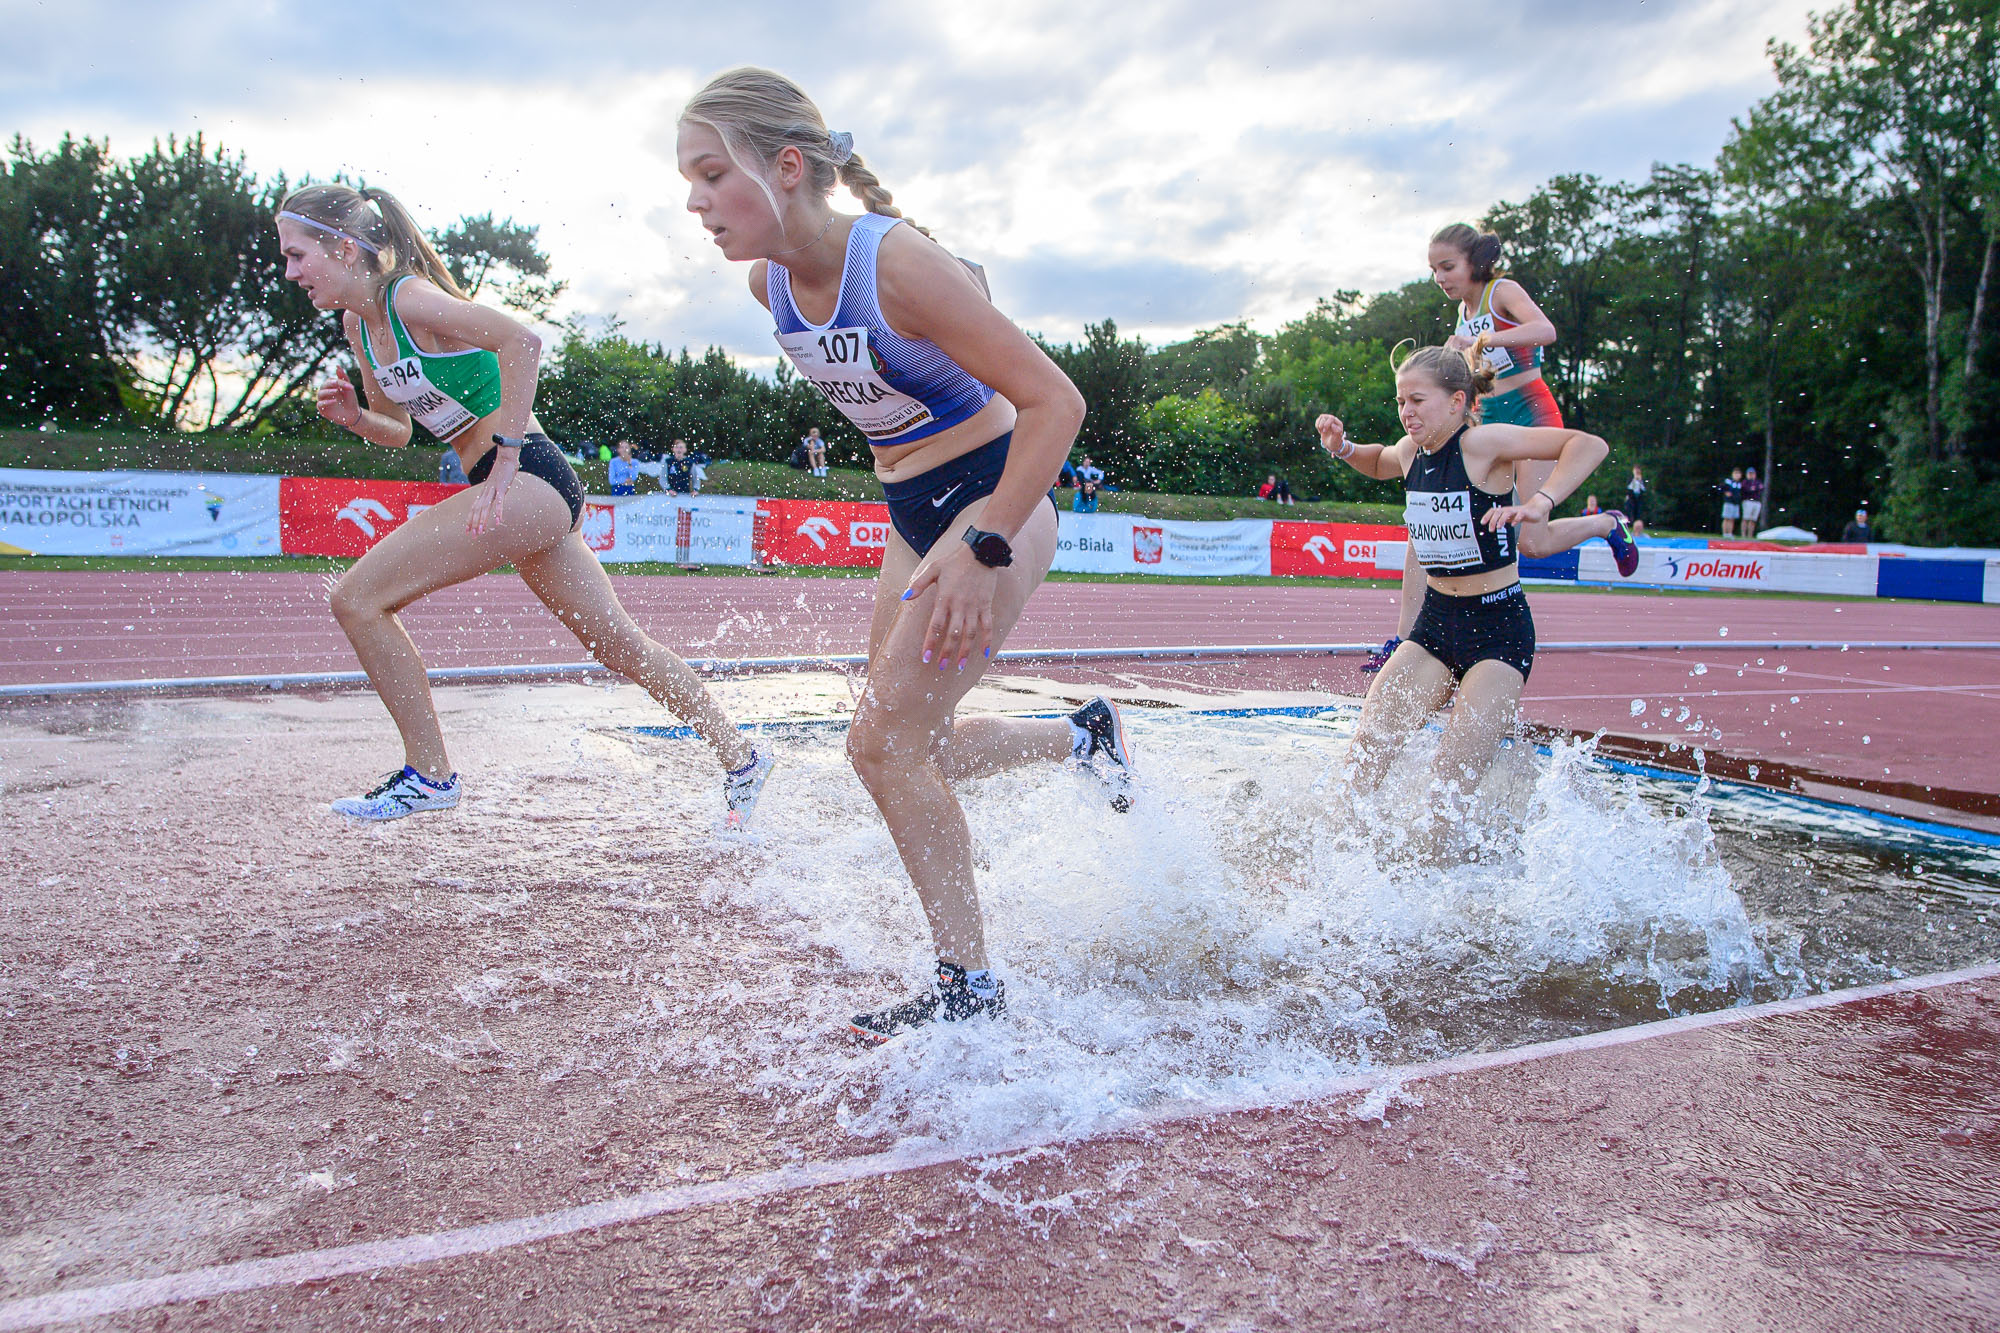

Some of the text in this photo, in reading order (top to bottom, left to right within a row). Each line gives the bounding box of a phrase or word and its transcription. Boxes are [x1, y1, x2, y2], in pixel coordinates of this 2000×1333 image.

[1468, 318, 1490, 337] 156
[818, 333, 859, 363] 107
[881, 413, 905, 427] Polski
[904, 403, 922, 415] U18
[97, 496, 170, 512] LETNICH
[1431, 495, 1464, 512] 344
[1406, 522, 1471, 541] SŁANOWICZ
[626, 533, 740, 551] Sportu urystyki
[1685, 558, 1764, 581] polanik
[1481, 590, 1507, 604] NIKE
